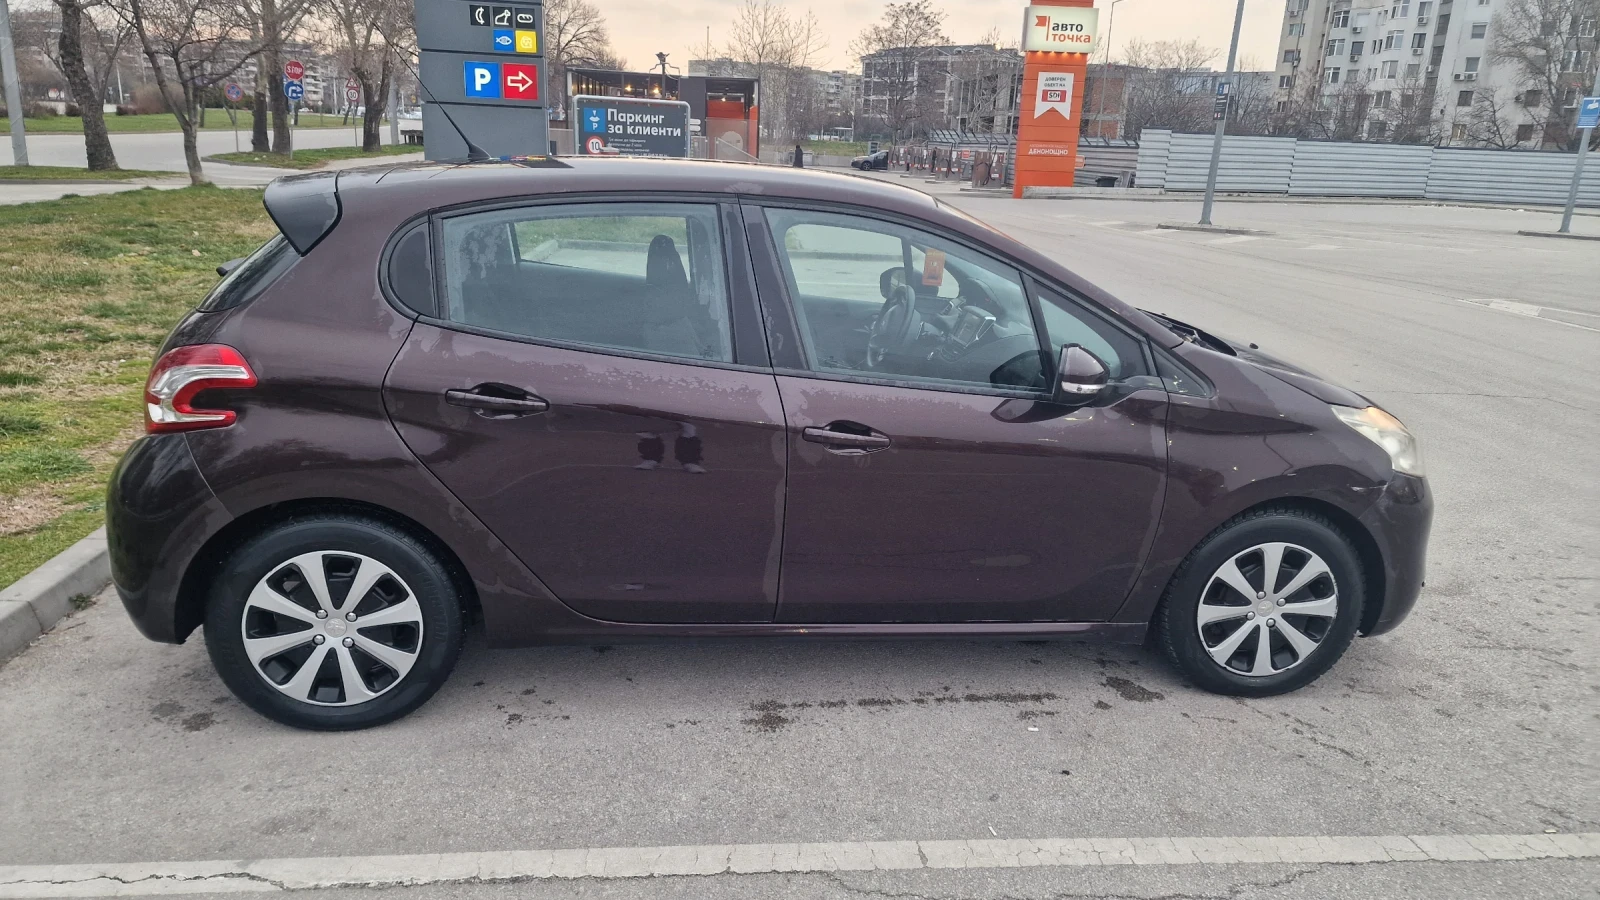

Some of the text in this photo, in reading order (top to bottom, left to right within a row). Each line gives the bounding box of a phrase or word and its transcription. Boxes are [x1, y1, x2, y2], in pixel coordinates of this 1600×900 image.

[1052, 23, 1083, 32] авто
[1052, 34, 1091, 43] точка
[286, 65, 303, 75] STOP
[474, 68, 491, 91] P
[607, 108, 665, 125] Паркинг
[592, 123, 598, 131] P
[607, 124, 681, 137] за клиенти
[591, 141, 600, 151] 10
